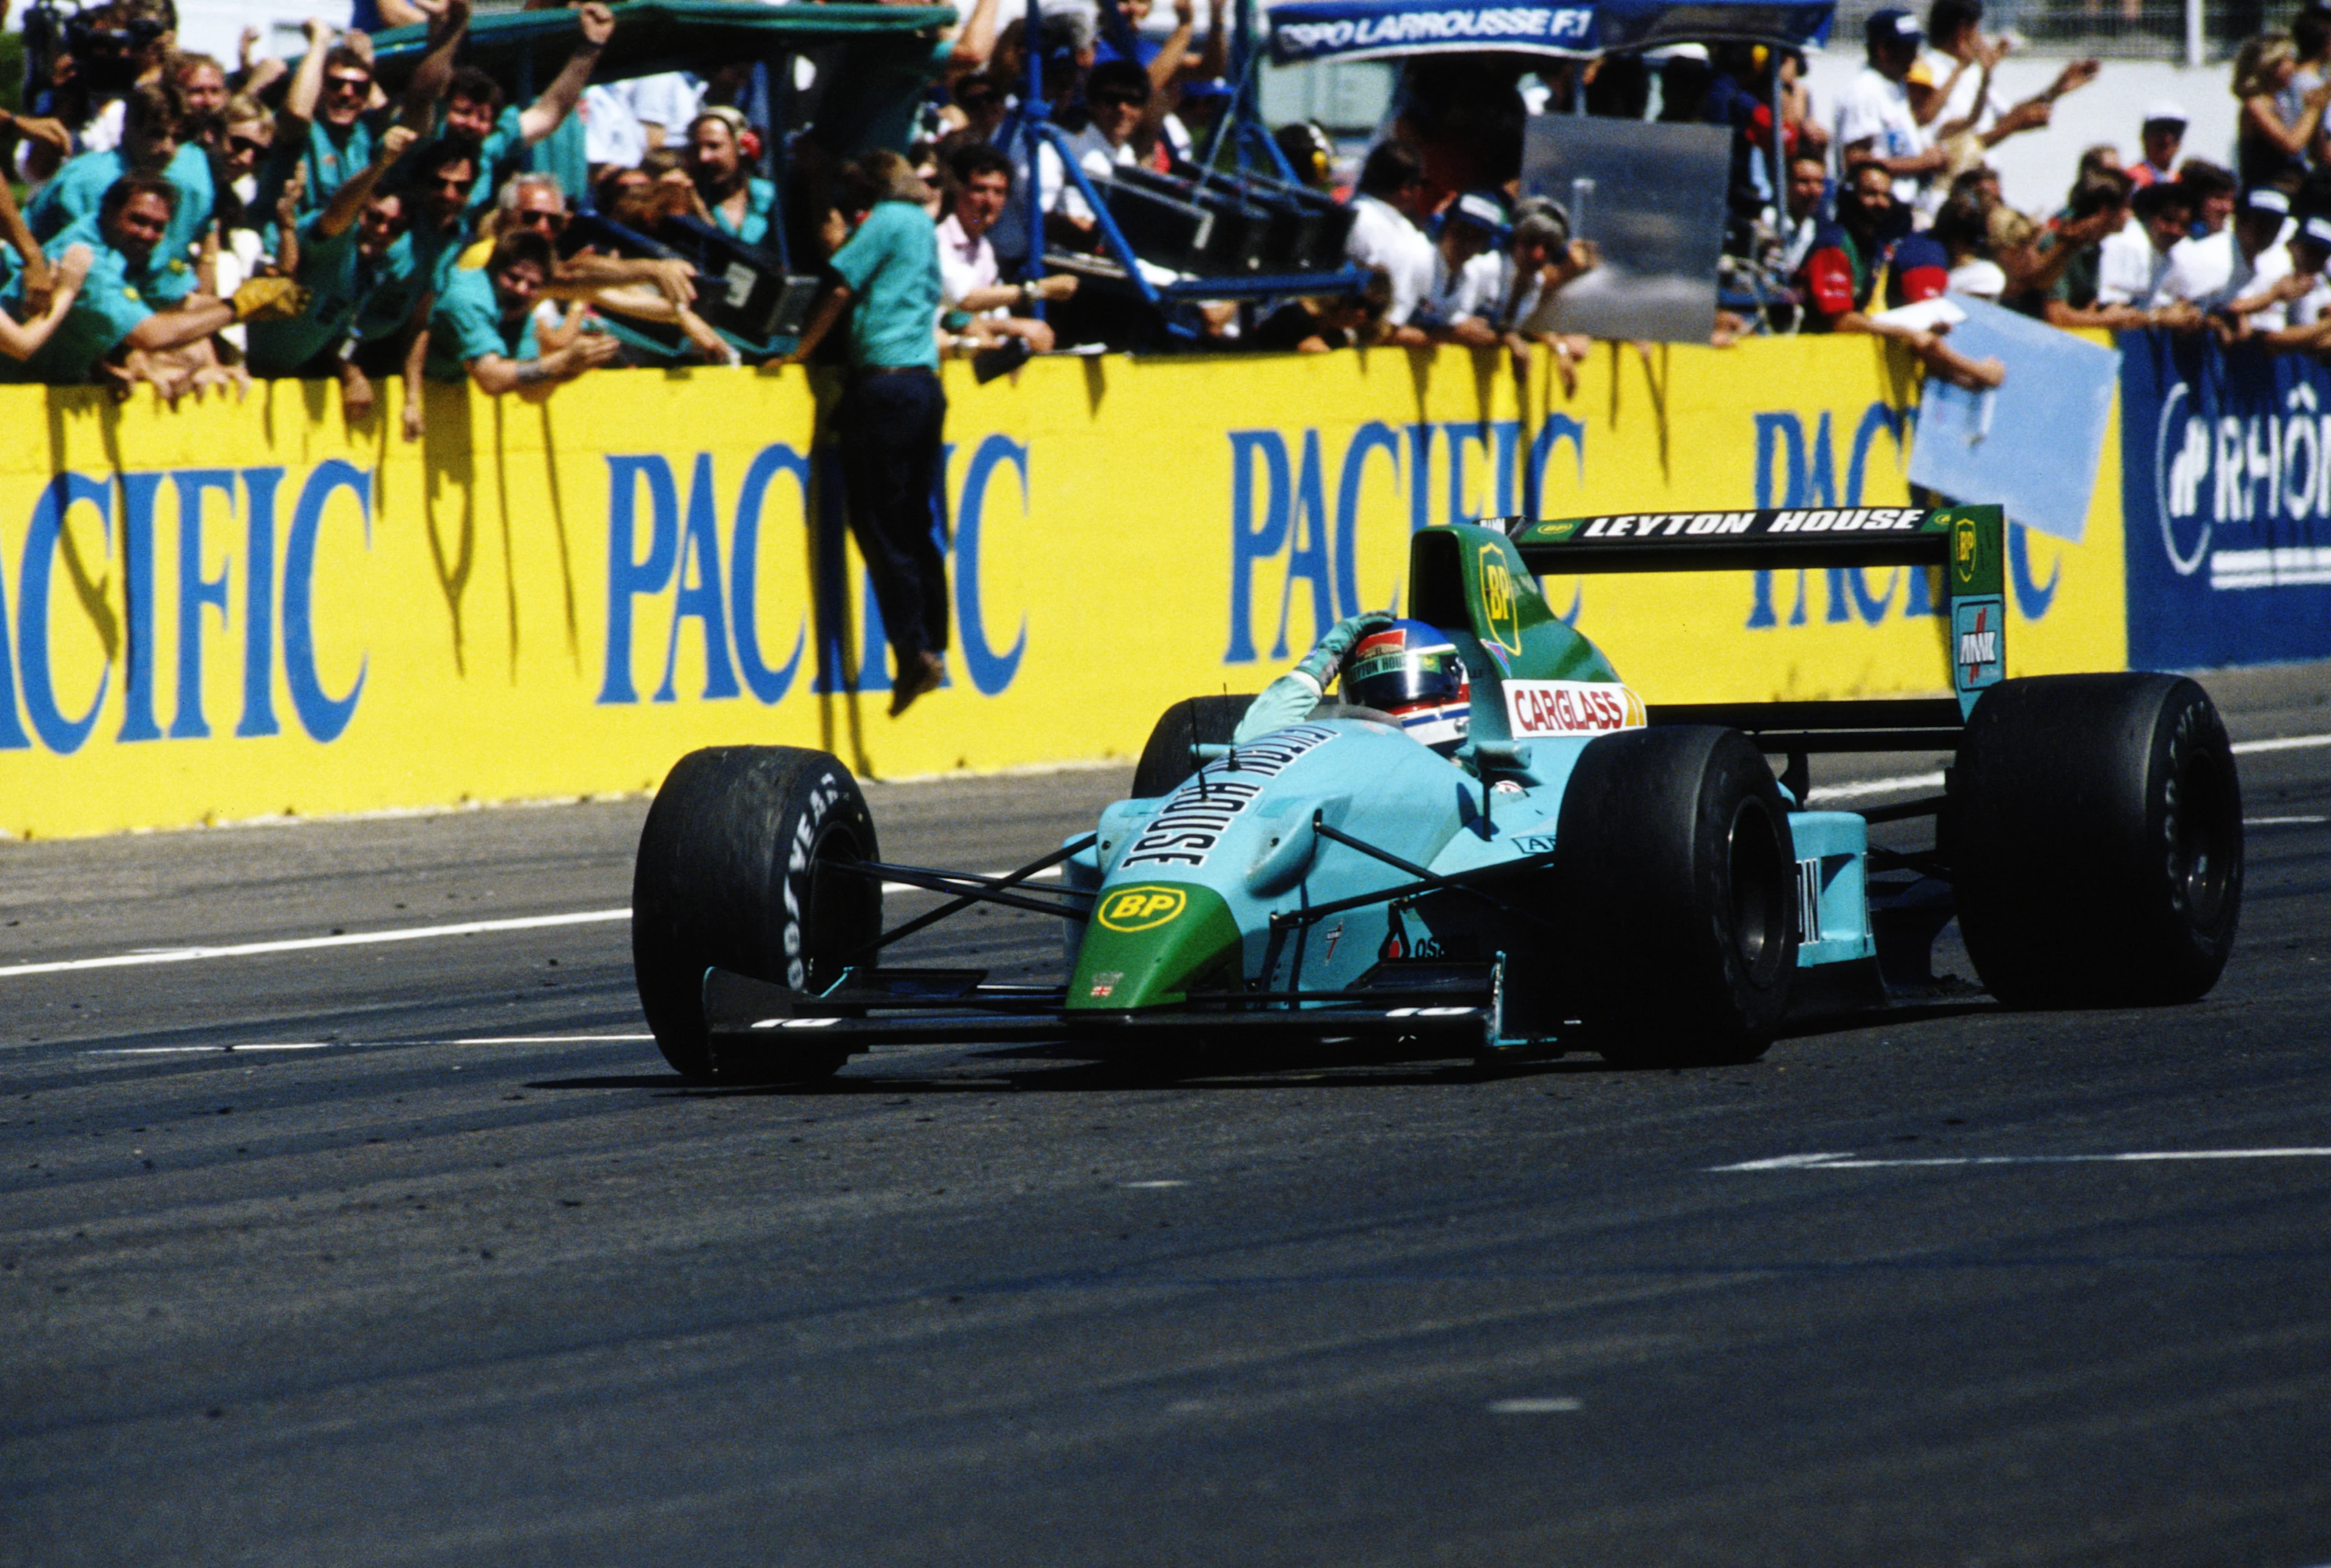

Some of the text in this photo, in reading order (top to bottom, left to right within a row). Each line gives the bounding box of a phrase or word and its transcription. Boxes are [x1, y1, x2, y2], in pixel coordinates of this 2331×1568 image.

[1354, 8, 1550, 44] LARROUSSE
[1583, 510, 1924, 537] LEYTON HOUSE
[1959, 530, 1974, 561] BP
[594, 433, 1029, 705] PACIC
[0, 458, 375, 756] CIFIC
[1486, 565, 1510, 620] BP
[1514, 689, 1623, 731] CARGLASS
[1120, 781, 1262, 869] HOUSE
[1109, 894, 1175, 919] BP
